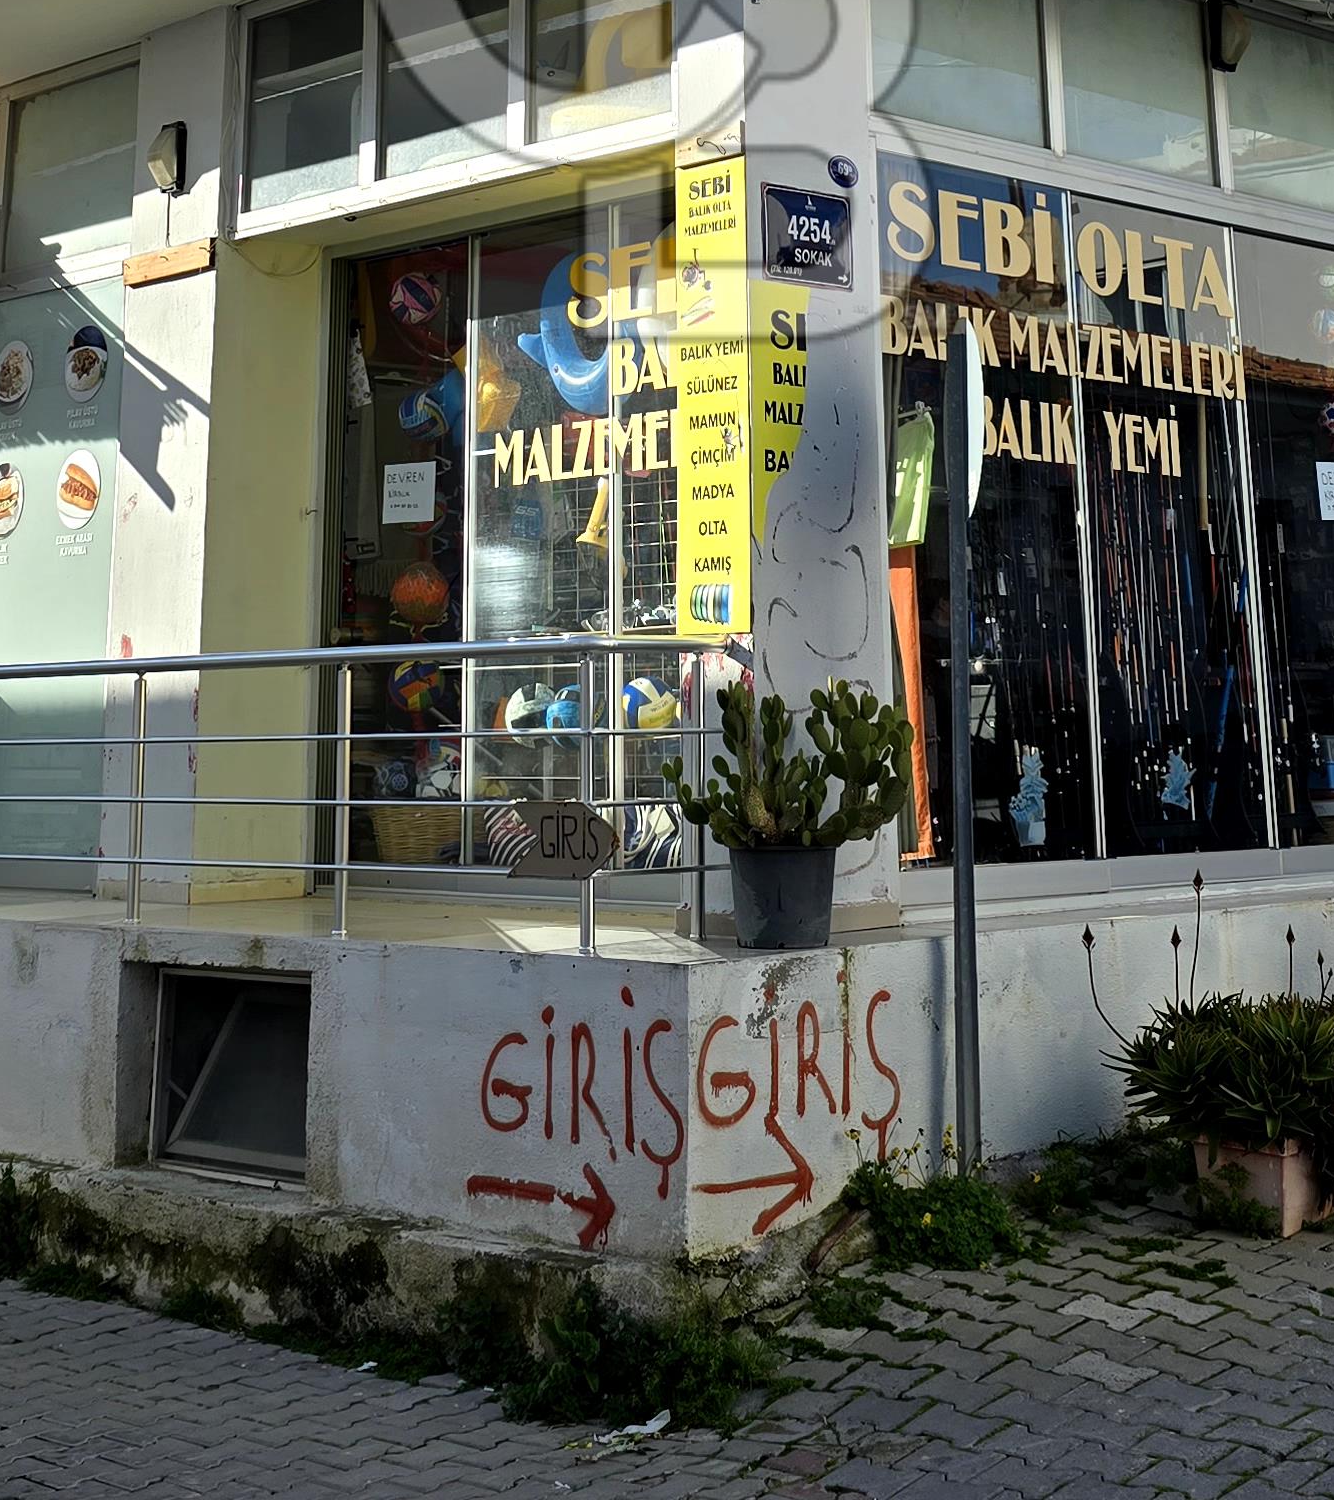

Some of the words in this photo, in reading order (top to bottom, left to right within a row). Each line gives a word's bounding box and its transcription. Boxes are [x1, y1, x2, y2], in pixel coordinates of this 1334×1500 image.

[688, 169, 731, 200] SEBİ
[688, 203, 711, 218] BALIK
[712, 200, 732, 214] OLTA
[787, 215, 831, 245] 4254
[794, 247, 832, 267] SOKAK
[887, 181, 1055, 285] SEBİ
[1077, 220, 1234, 319] OLTA
[680, 342, 713, 362] BALIK
[715, 335, 744, 356] YEMİ
[880, 294, 1001, 368] BALK
[1008, 312, 1246, 401] MALZEMELERİ
[686, 374, 738, 395] SÜLÜNEZ
[689, 411, 736, 430] MAMUN
[1103, 404, 1181, 477] YEMİ
[690, 444, 735, 469] ÇİMÇİM
[764, 449, 795, 472] BA
[387, 471, 425, 484] DEVREN
[692, 483, 735, 501] MADYA
[699, 520, 728, 536] OLTA
[694, 556, 732, 575] KAMIŞ
[540, 809, 600, 863] GİRİŞ
[696, 967, 901, 1163] GİRİŞ
[480, 984, 685, 1200] GİRİŞ
